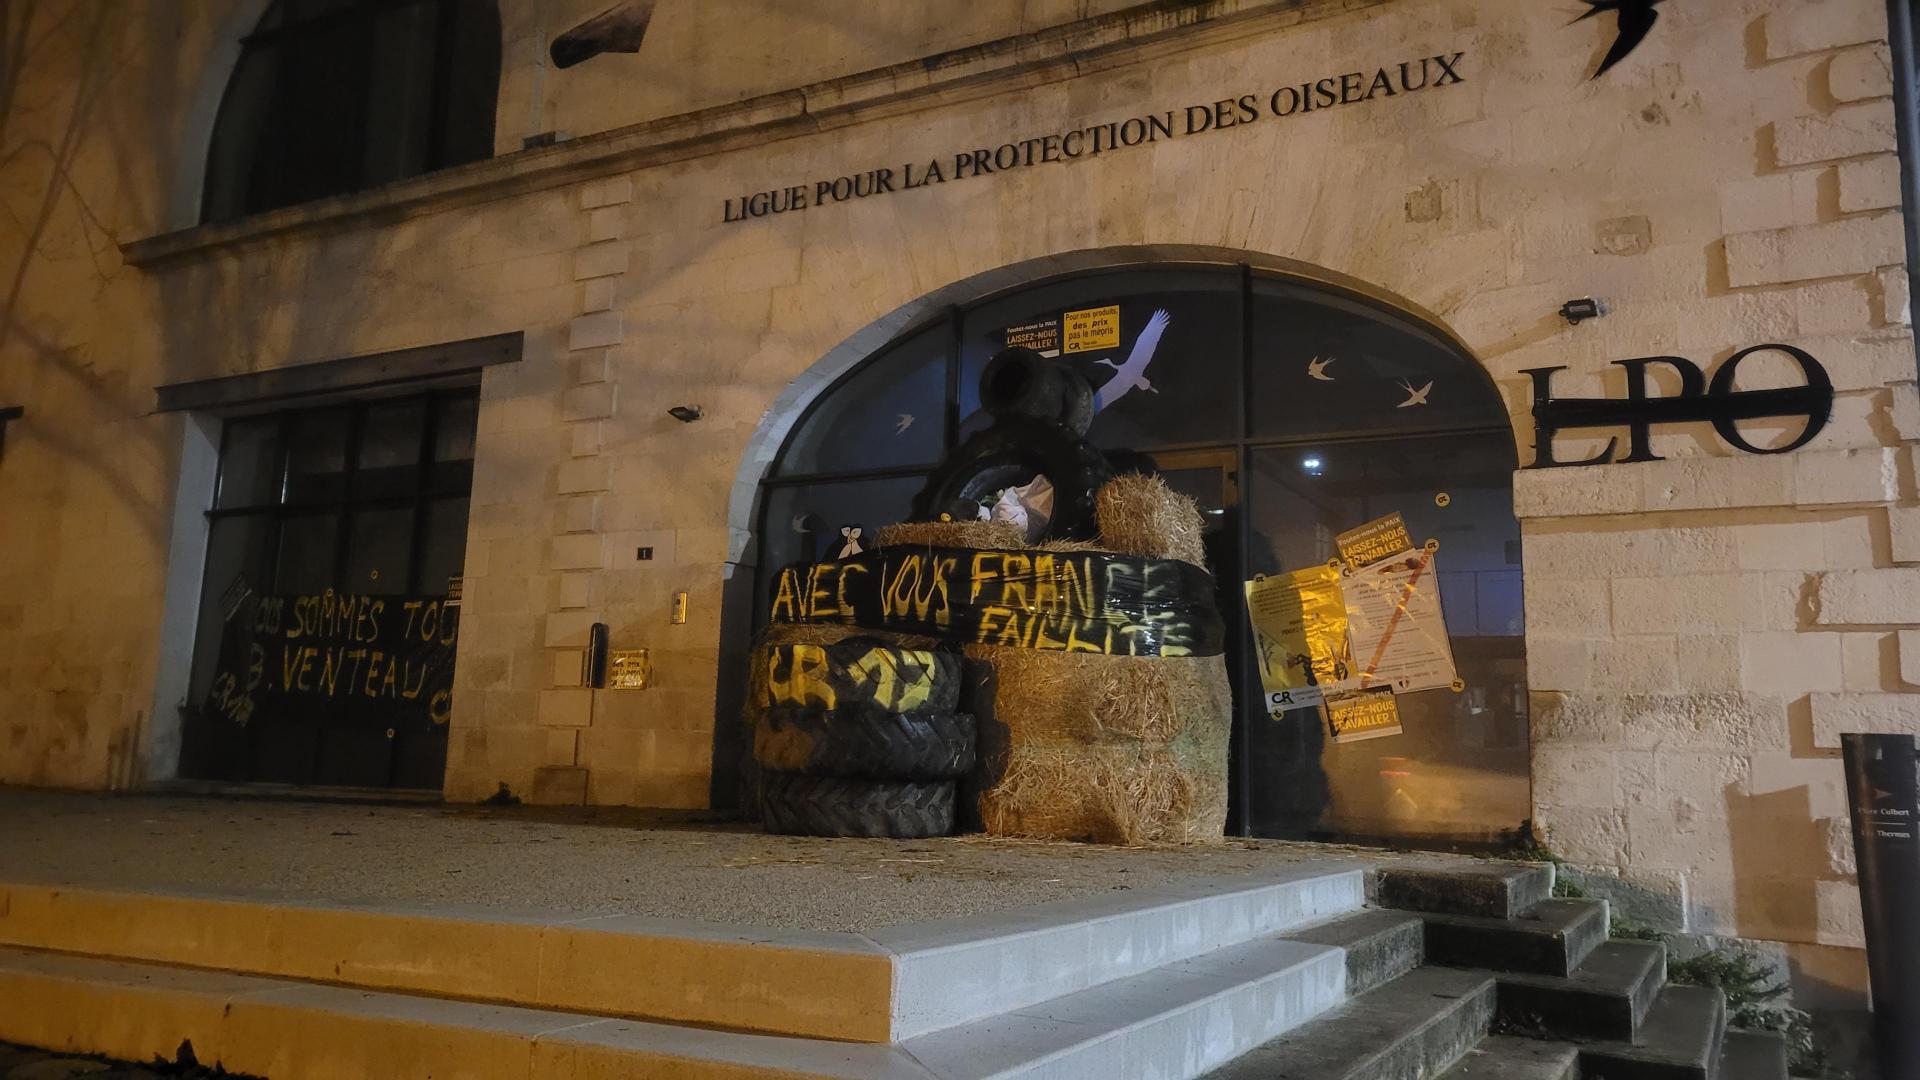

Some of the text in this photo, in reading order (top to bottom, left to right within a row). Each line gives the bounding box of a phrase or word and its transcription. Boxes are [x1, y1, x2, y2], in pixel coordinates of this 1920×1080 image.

[723, 51, 1465, 223] LIGUE POUR LA PROTECTION DES OISEAUX
[1072, 318, 1108, 330] des prix
[1007, 328, 1058, 344] LAISSEZ-NOUS
[1007, 338, 1052, 350] VAILLER
[1068, 331, 1081, 341] pas
[1082, 329, 1089, 338] le
[1068, 342, 1081, 350] CR
[1518, 343, 1834, 469] LPO
[1384, 516, 1401, 528] PAIX
[1343, 526, 1406, 558] LAISSEZ-NOUS
[1347, 539, 1404, 568] TRAVAILLER
[771, 563, 869, 624] AVEC
[880, 554, 958, 628] VOUS
[969, 551, 1177, 630] FRANCE
[286, 594, 385, 643] SOMMES
[976, 606, 1193, 657] FAILLITE
[283, 645, 427, 698] VENTEAU
[1271, 691, 1294, 704] CR
[1375, 689, 1392, 699] PAIX
[1333, 700, 1395, 720] AISSEZ-NOUS
[1880, 807, 1910, 816] Colbert
